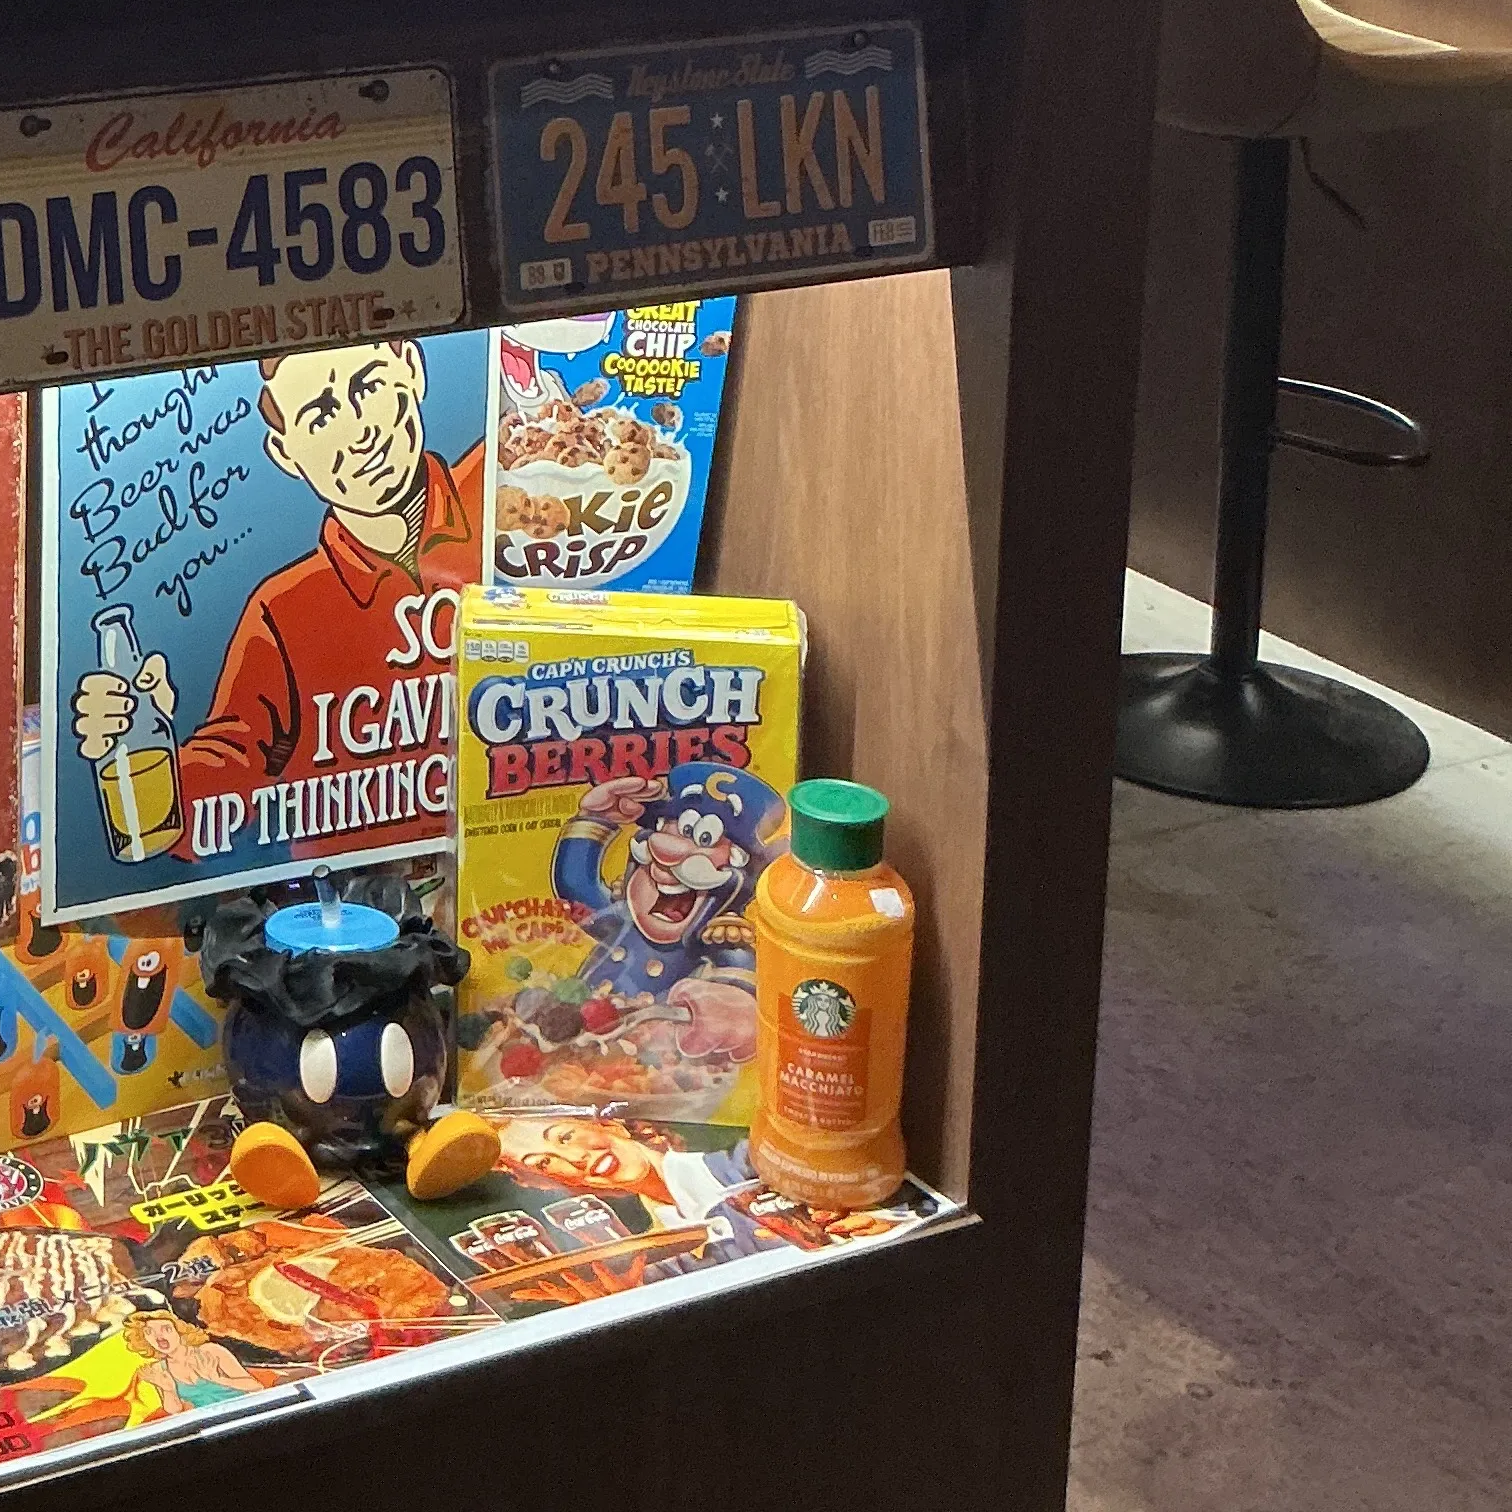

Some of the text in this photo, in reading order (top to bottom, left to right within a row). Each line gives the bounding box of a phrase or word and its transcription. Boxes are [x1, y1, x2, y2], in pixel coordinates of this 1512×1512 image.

[86, 108, 346, 173] California
[540, 86, 885, 243] 245 LKN
[586, 223, 855, 283] PENNSYLVANIA
[63, 291, 389, 370] THE GOLDEN STATE
[627, 301, 701, 321] GREAT
[627, 320, 695, 334] CHOCOLATE
[626, 333, 698, 358] CHIP
[624, 377, 685, 397] TASTE!
[70, 397, 251, 543] Beer was
[81, 461, 250, 600] Bad for
[385, 588, 460, 666] SO
[531, 650, 691, 681] CAP'N CRUNCH'S
[313, 692, 336, 765] I
[477, 666, 764, 744] CRUNCH
[486, 726, 749, 798] BERRIES
[192, 792, 245, 856] UP
[251, 753, 449, 846] THINKING
[780, 1070, 864, 1096] MACCHIATO
[788, 1062, 854, 1085] CARAMEL
